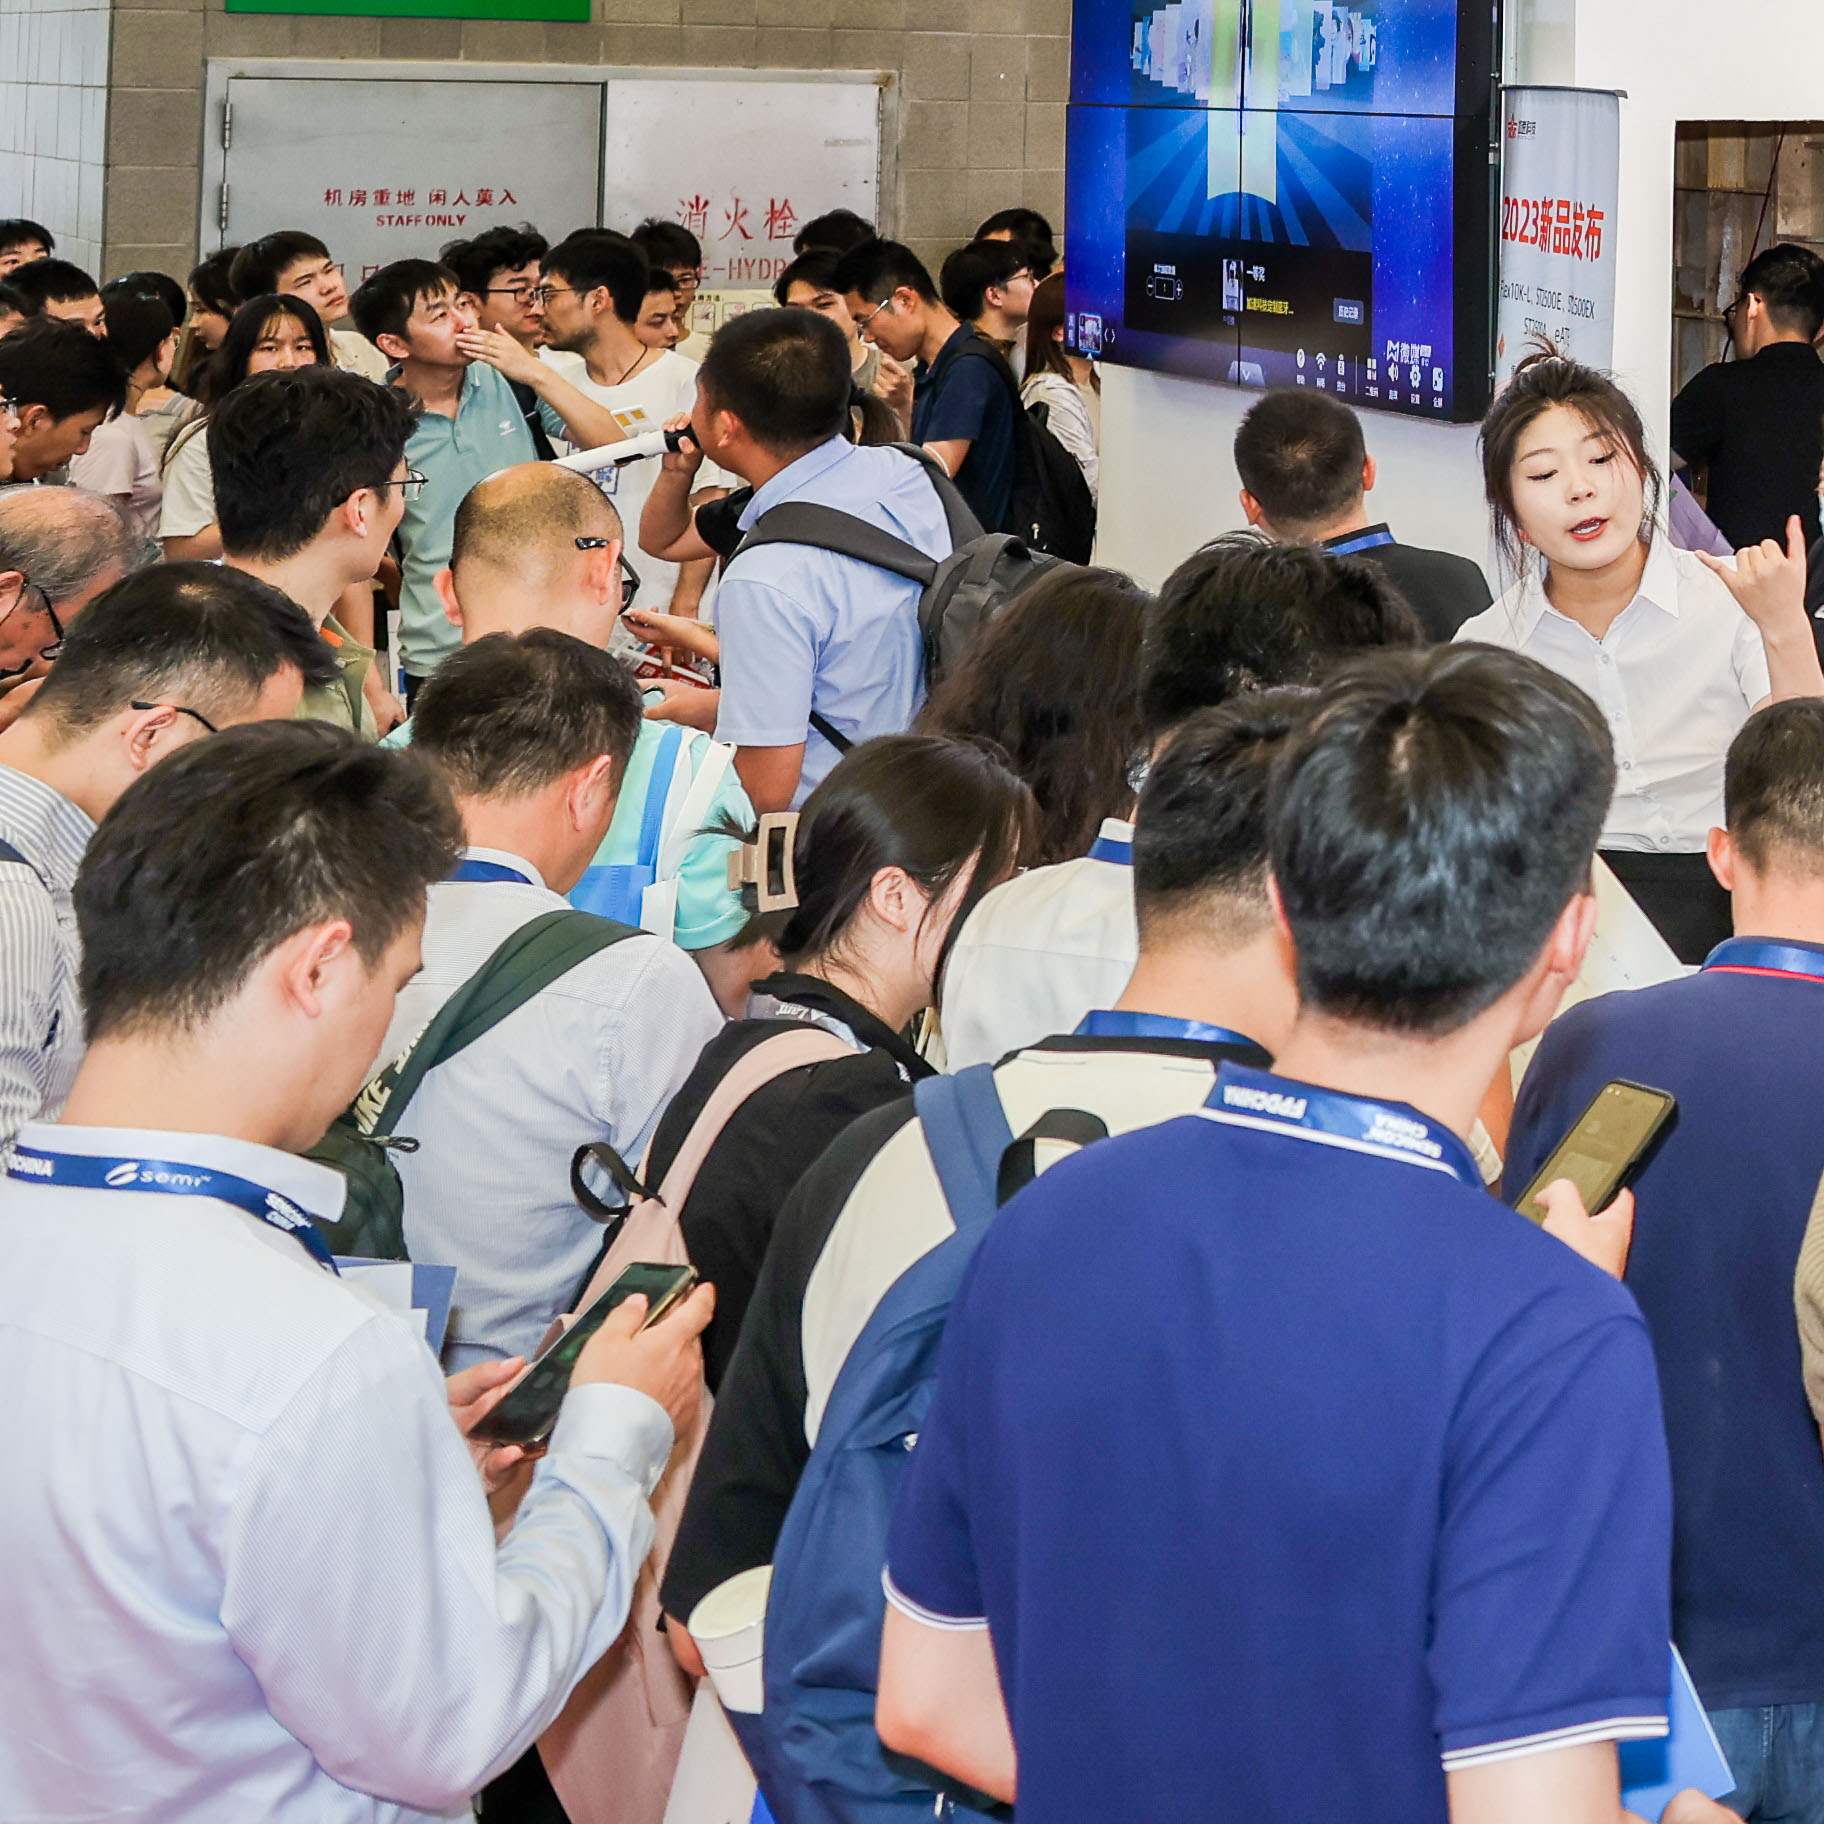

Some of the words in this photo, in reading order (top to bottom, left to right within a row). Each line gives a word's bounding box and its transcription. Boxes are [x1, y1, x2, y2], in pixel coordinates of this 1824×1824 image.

[323, 188, 417, 208] 机房重地
[427, 188, 519, 208] 闲人莫入
[375, 213, 423, 228] STAFF
[425, 212, 467, 228] ONLY
[676, 194, 798, 241] 消火栓
[1502, 196, 1605, 262] 2023新品发布
